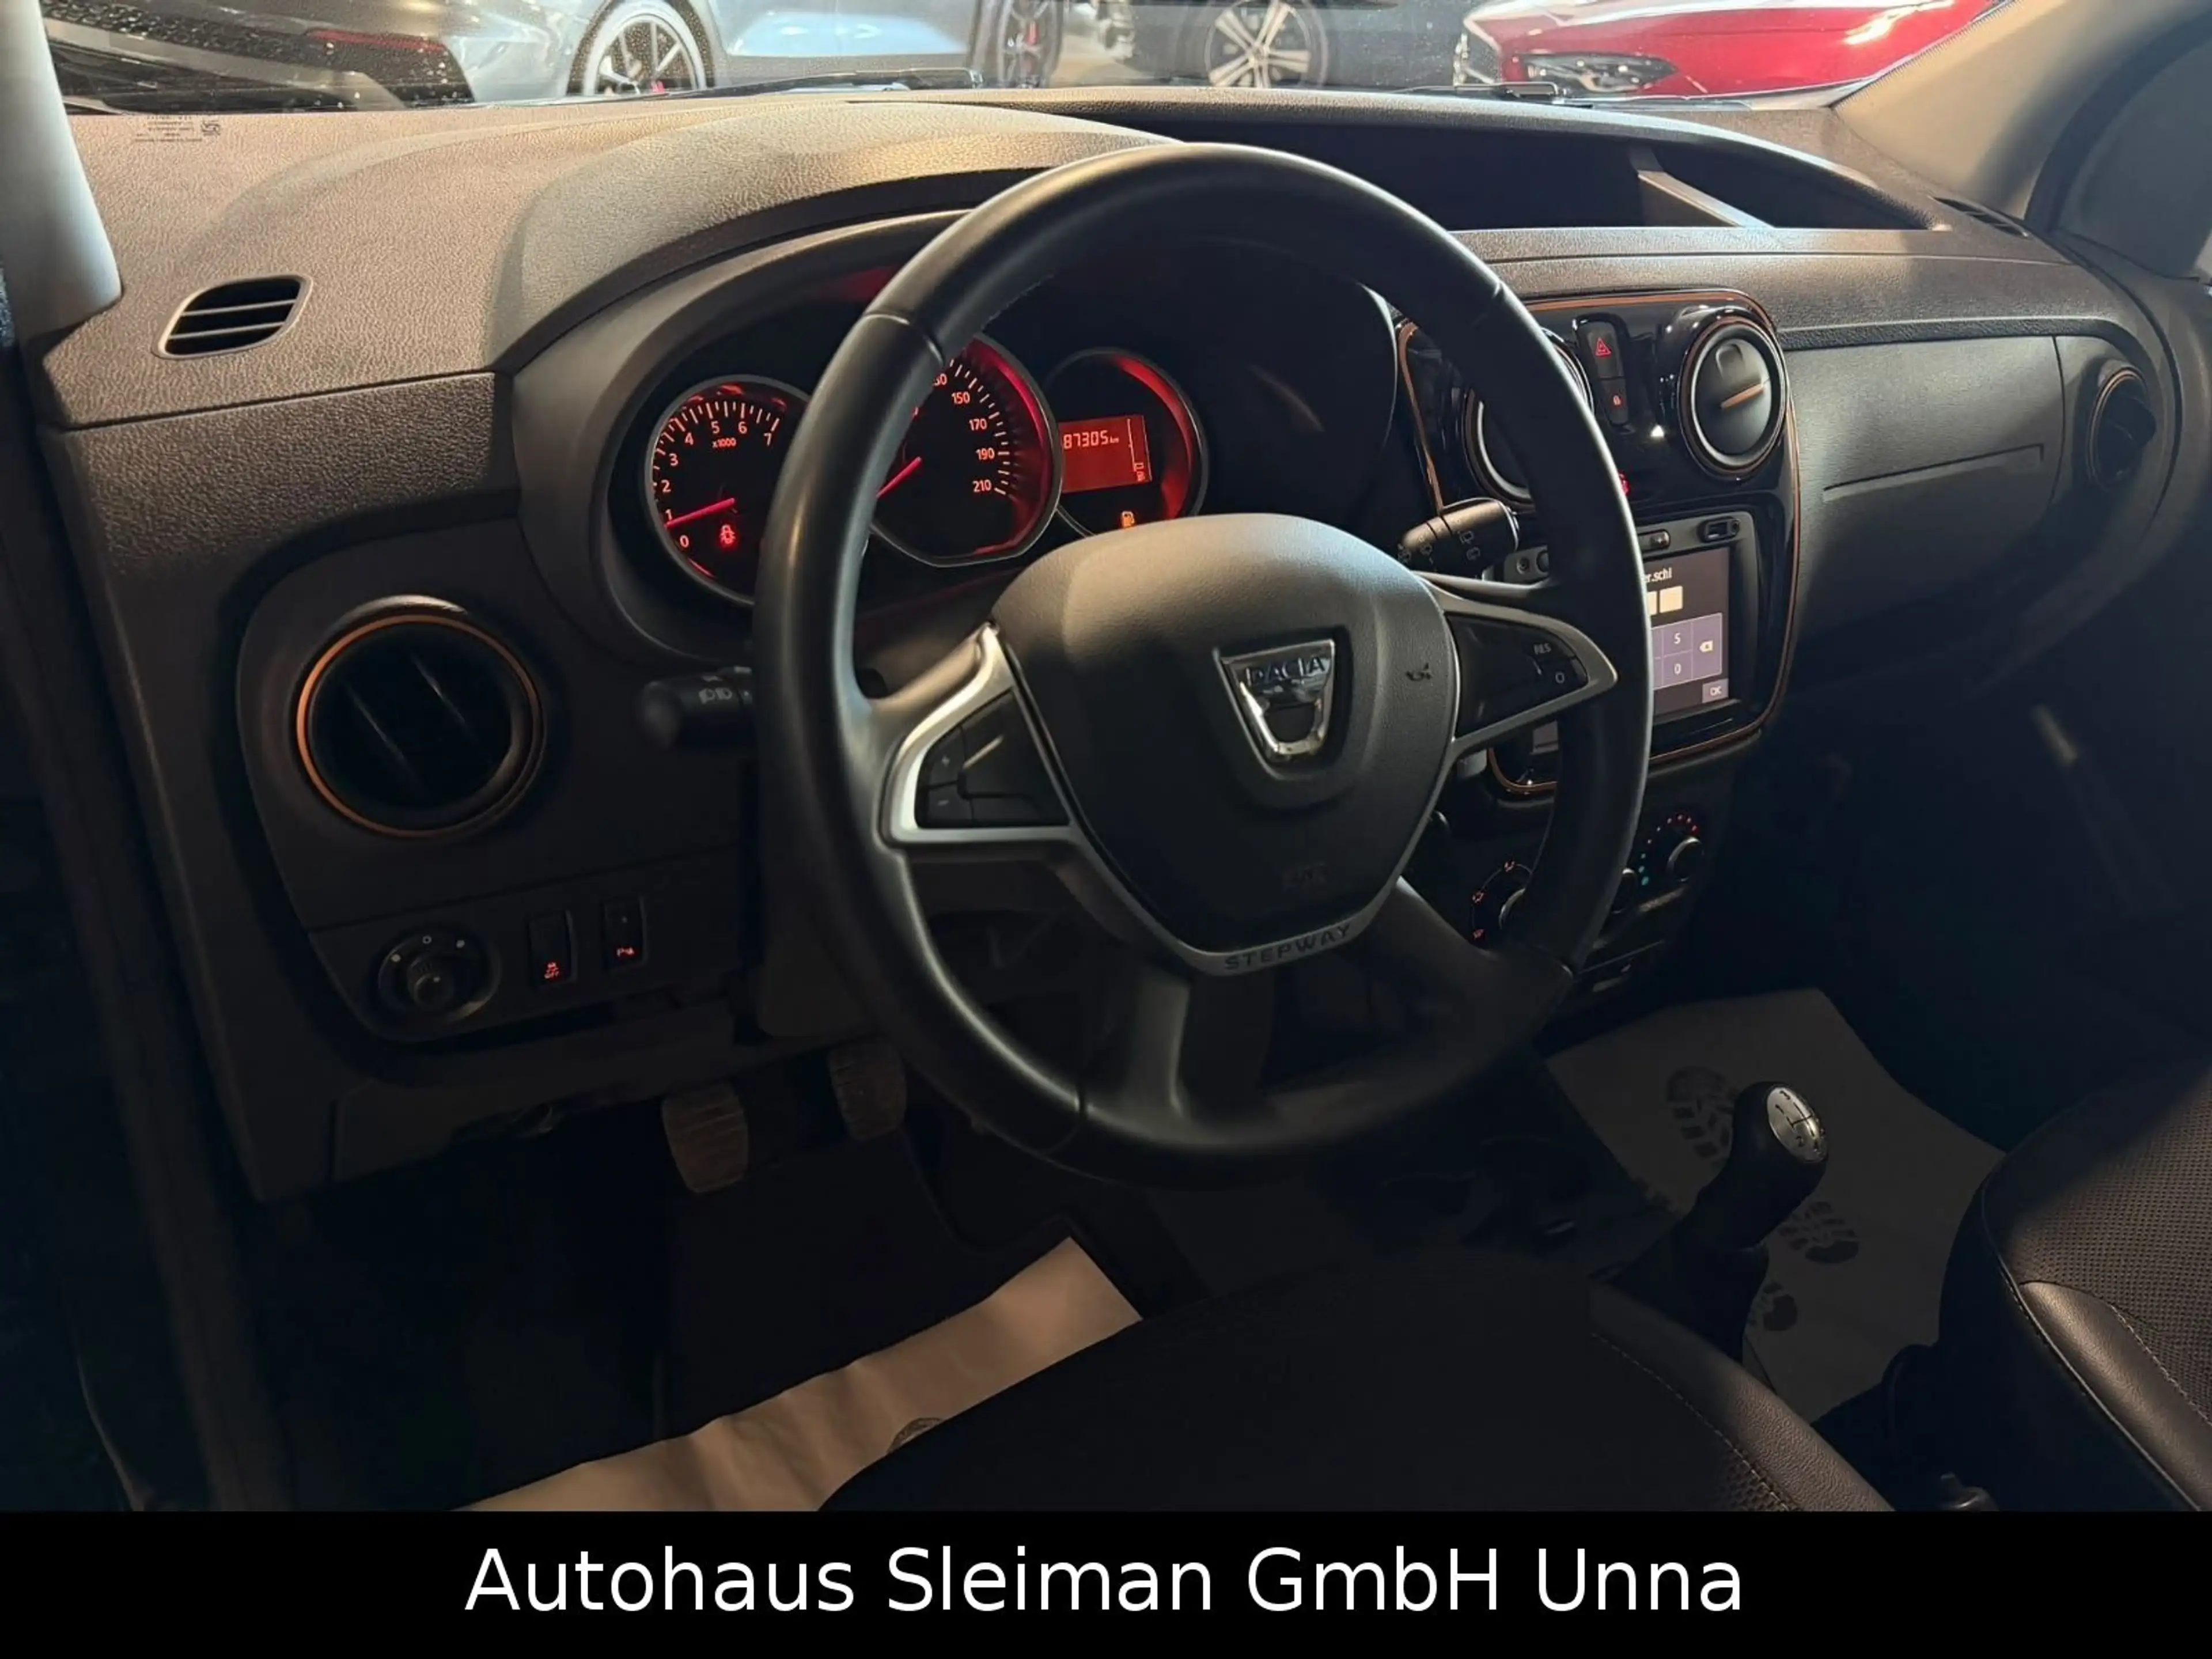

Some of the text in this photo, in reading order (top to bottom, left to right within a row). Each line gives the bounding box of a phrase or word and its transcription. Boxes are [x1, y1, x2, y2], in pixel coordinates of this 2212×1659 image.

[951, 391, 971, 404] 150
[711, 421, 720, 434] 5
[738, 421, 748, 434] 6
[969, 418, 987, 431] 170
[684, 432, 694, 445] 4
[712, 437, 737, 448] x1000
[763, 433, 772, 446] 7
[1063, 429, 1109, 450] 87305
[669, 453, 679, 467] 3
[976, 447, 995, 460] 190
[661, 479, 671, 493] 2
[972, 479, 993, 493] 210
[665, 509, 673, 520] 1
[679, 535, 690, 548] 0
[1673, 632, 1681, 644] 5
[1224, 923, 1350, 970] STEPWAY
